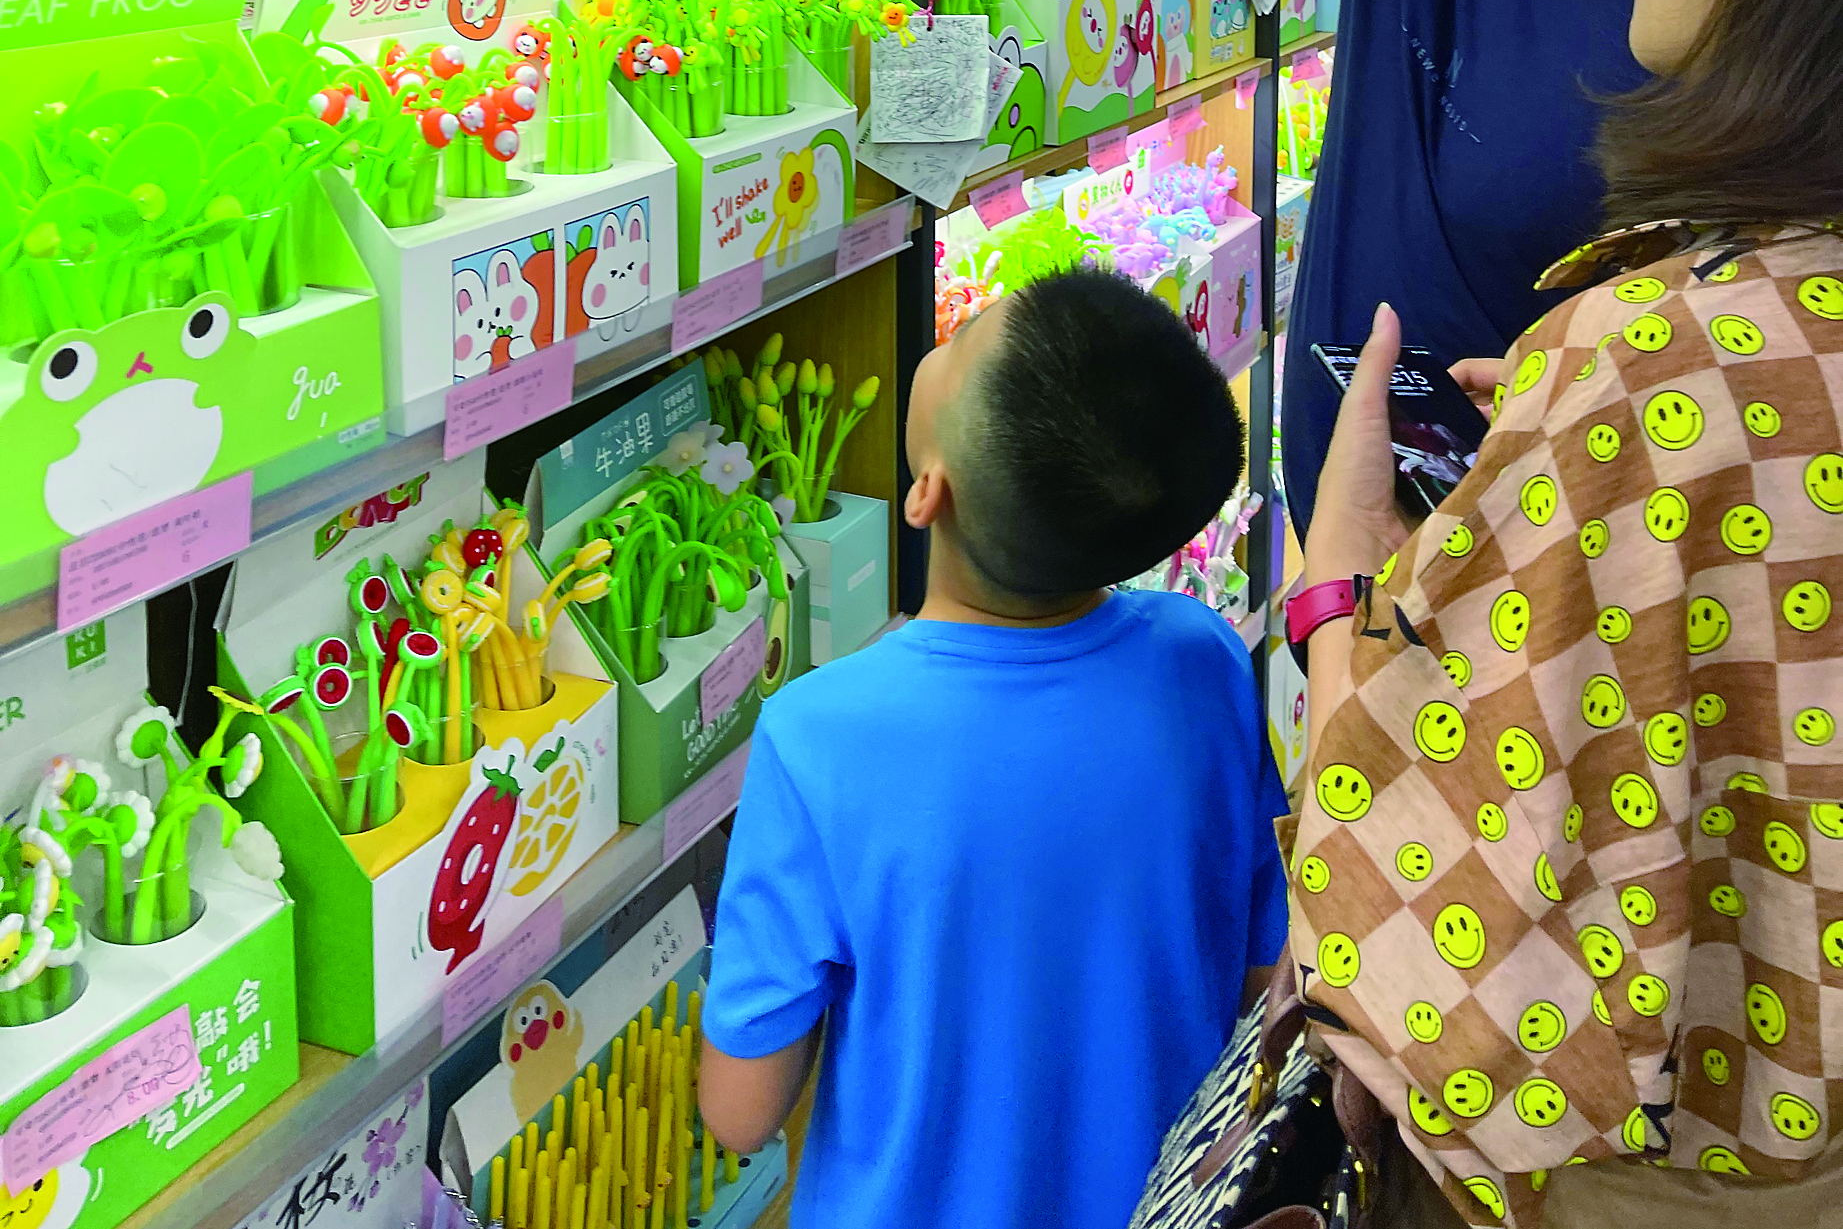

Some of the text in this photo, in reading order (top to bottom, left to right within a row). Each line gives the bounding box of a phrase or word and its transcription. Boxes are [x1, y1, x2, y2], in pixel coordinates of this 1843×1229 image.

[734, 177, 769, 210] shake
[717, 218, 742, 249] well
[286, 365, 342, 421] gua
[594, 411, 655, 478] 牛油果
